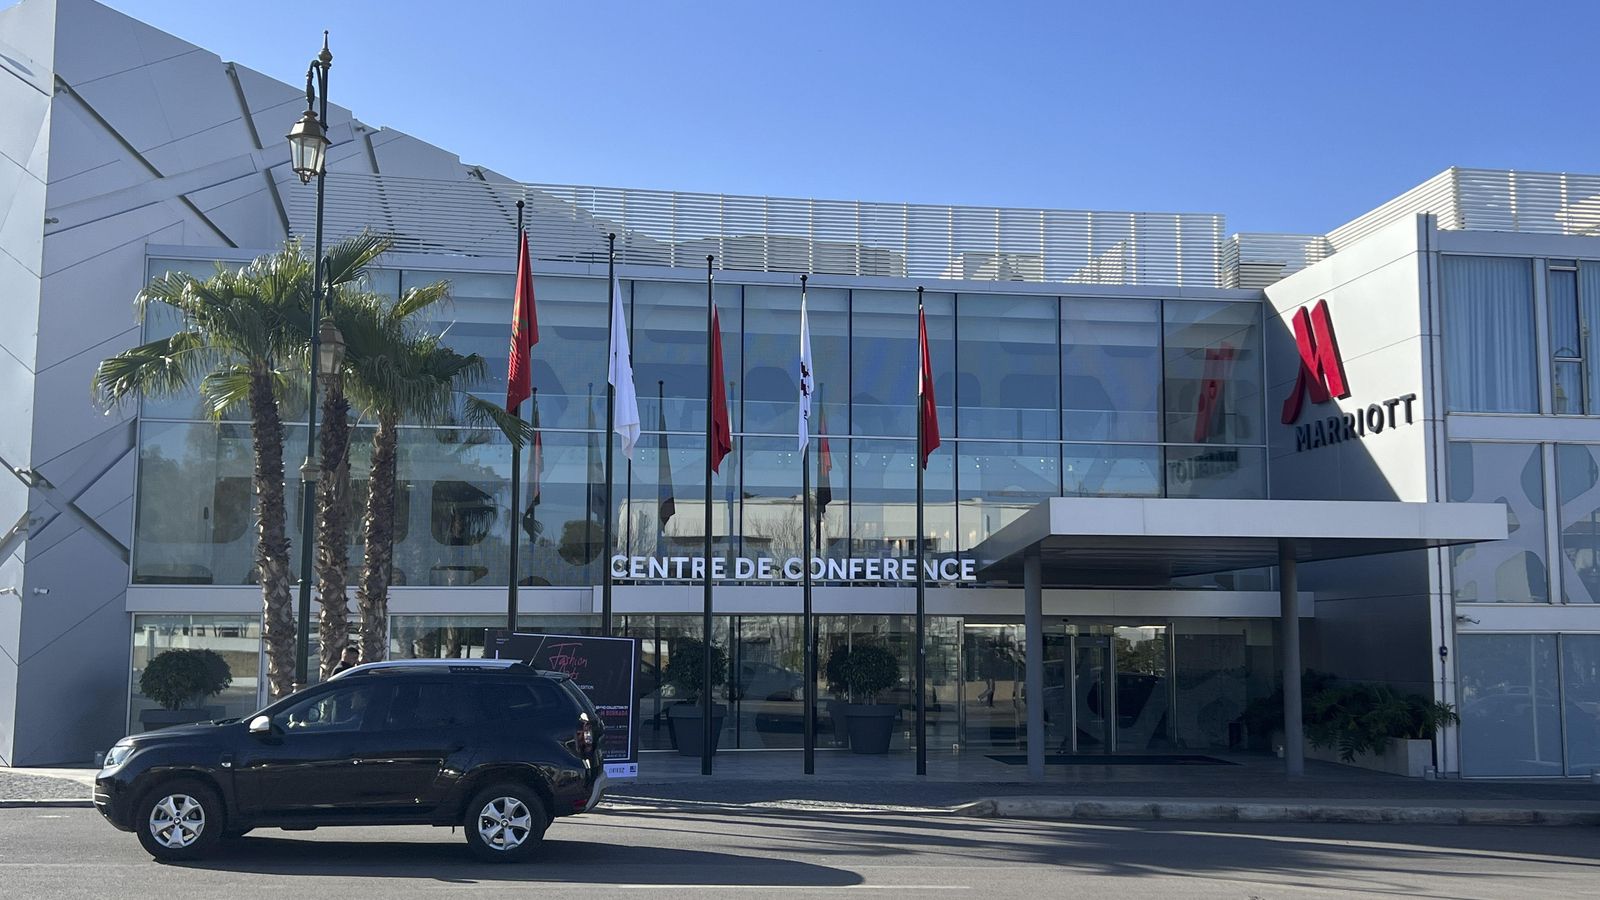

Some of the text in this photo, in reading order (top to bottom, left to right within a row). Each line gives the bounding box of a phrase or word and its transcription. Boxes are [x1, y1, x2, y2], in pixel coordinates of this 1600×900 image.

[1295, 393, 1417, 452] MARRIOTT
[611, 555, 977, 580] CENTRE DE CONFERENCE
